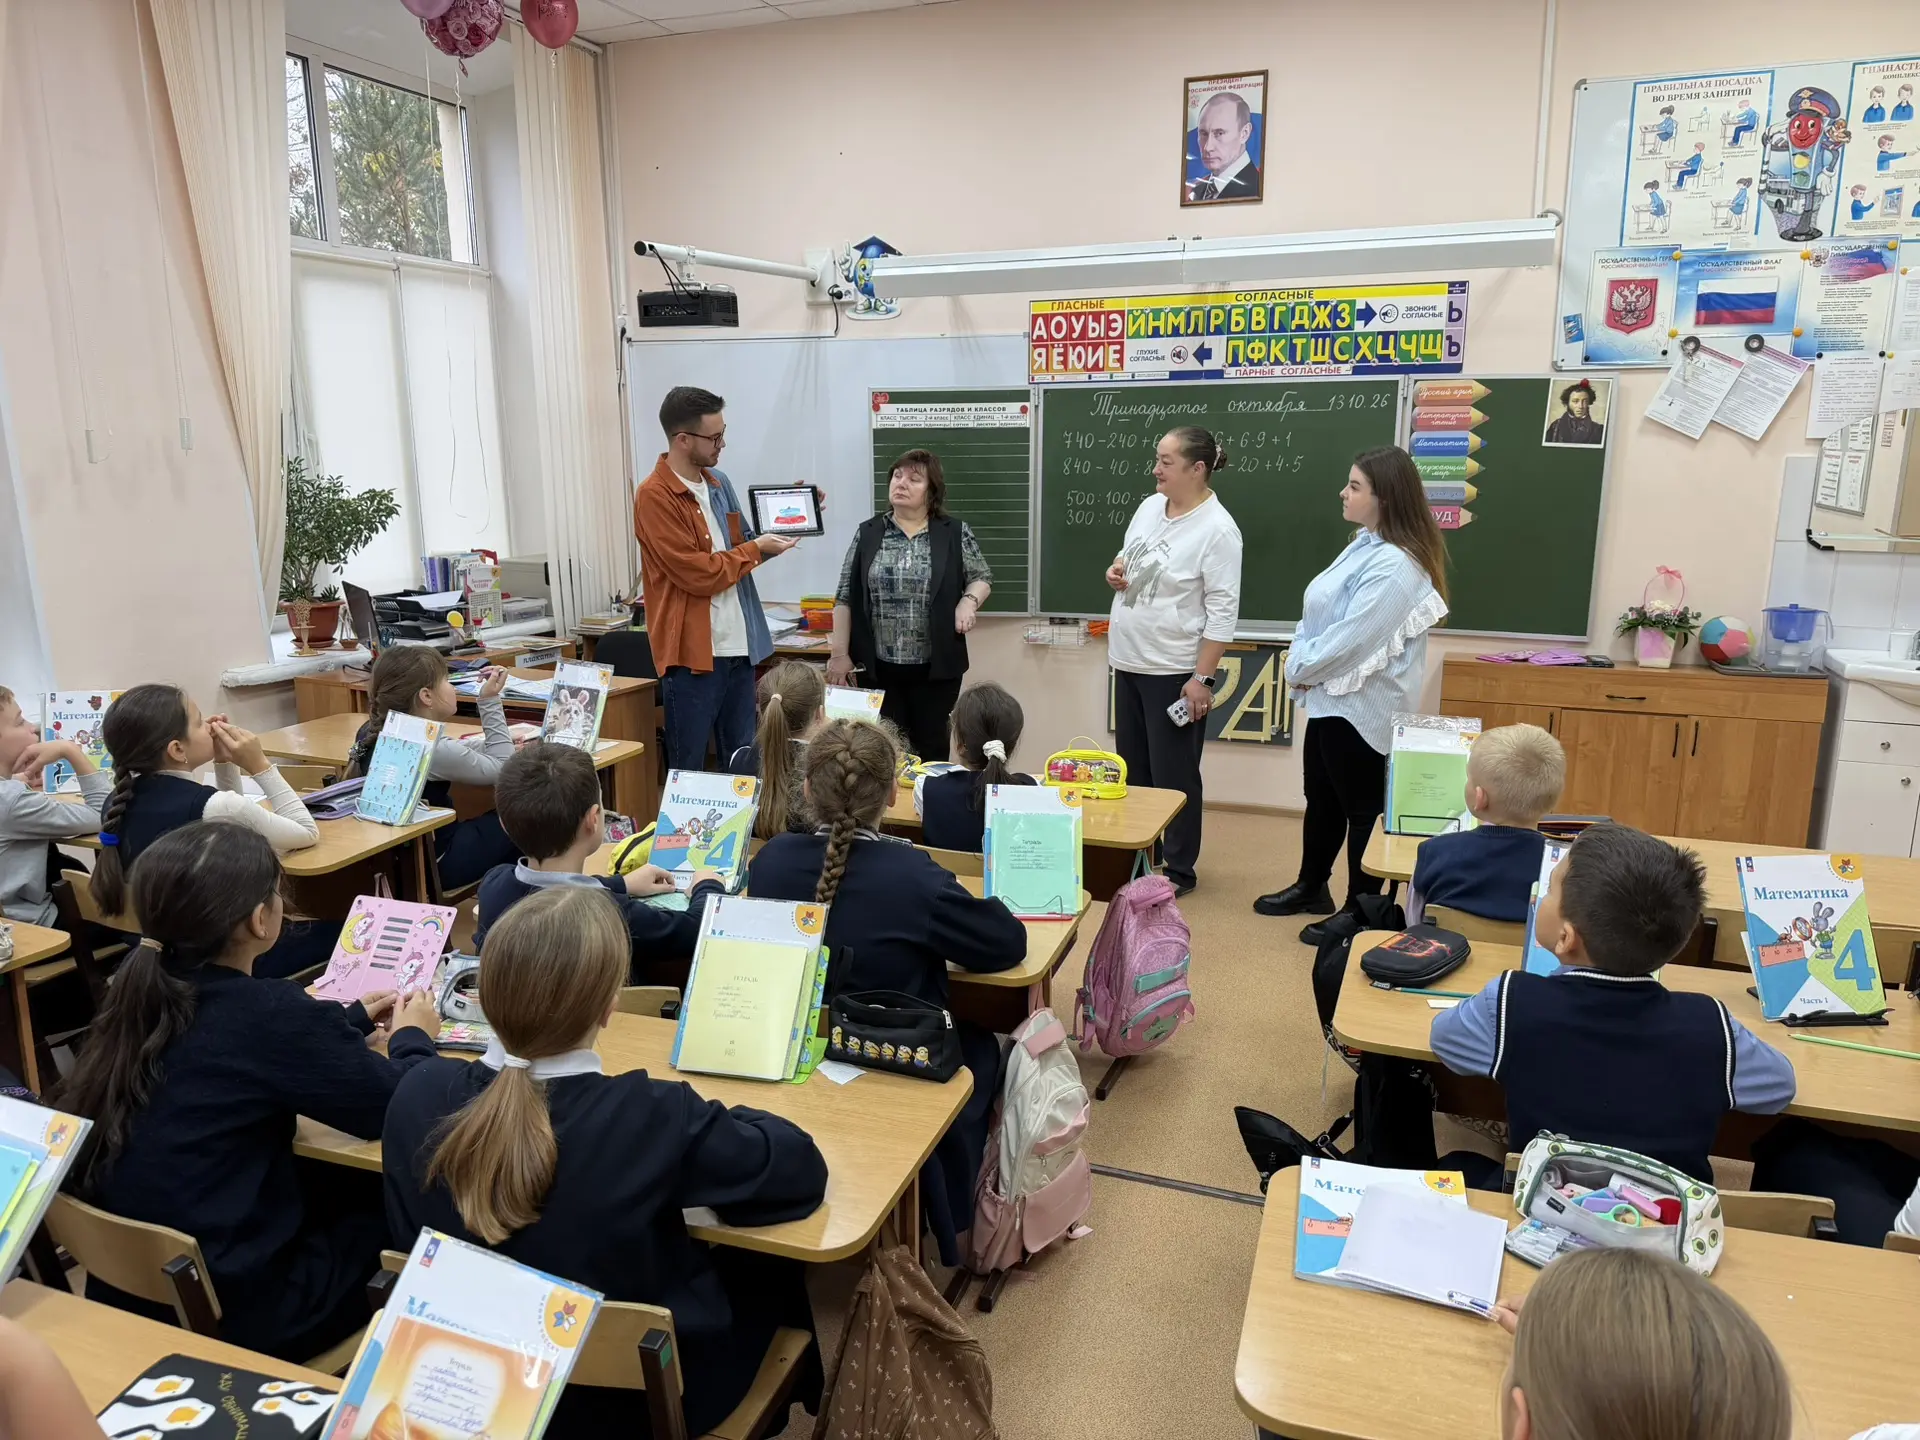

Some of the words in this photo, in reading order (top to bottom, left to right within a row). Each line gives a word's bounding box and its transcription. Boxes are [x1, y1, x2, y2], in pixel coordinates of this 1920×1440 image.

[1643, 82, 1712, 93] ПРАВИЛЬНАЯ
[1714, 76, 1762, 87] ПОСАДКА
[1652, 95, 1665, 103] ВО
[1667, 91, 1700, 101] ВРЕМЯ
[1702, 87, 1752, 99] ЗАНЯТИЙ
[1235, 290, 1314, 302] СОГЛАСНЫЕ
[1051, 300, 1105, 310] ГЛАСНЫЕ
[1401, 311, 1443, 319] СОГЛАСНЫЕ
[1130, 354, 1166, 362] СОГЛАСНЫЕ
[1235, 368, 1275, 377] ПАРНЫЕ
[1281, 366, 1341, 375] СОГЛАСНЫЕ
[1419, 386, 1450, 399] Русский
[1090, 391, 1207, 428] Тринадцатое
[1228, 391, 1307, 422] октября
[523, 652, 556, 664] плакаты
[669, 793, 738, 809] Математика
[704, 831, 737, 868] 4
[1753, 887, 1849, 900] Математика
[1834, 929, 1876, 991] 4
[1314, 1178, 1365, 1196] Мате
